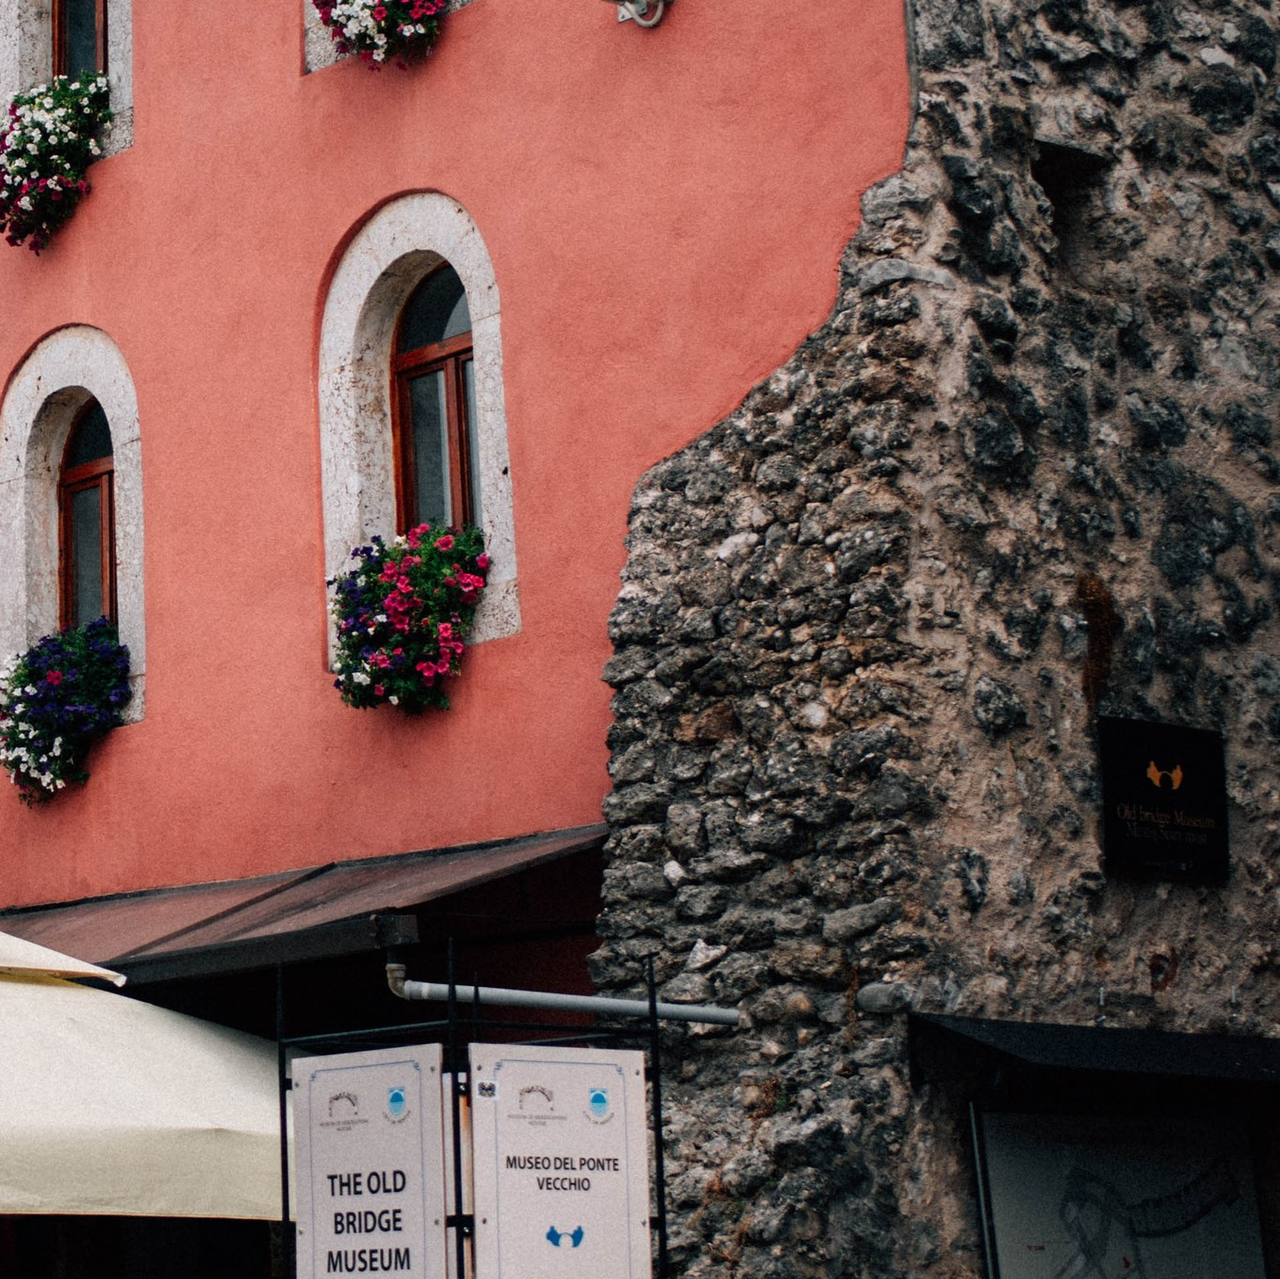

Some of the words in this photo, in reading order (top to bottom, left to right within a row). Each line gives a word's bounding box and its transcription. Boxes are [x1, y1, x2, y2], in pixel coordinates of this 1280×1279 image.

[505, 1155, 551, 1170] MUSEO
[553, 1156, 577, 1172] DEL
[579, 1157, 620, 1172] PONTE
[327, 1173, 363, 1197] THE
[367, 1169, 407, 1195] OLD
[536, 1177, 591, 1191] VECCHIO
[334, 1208, 402, 1235] BRIDGE
[327, 1247, 411, 1273] MUSEUM
